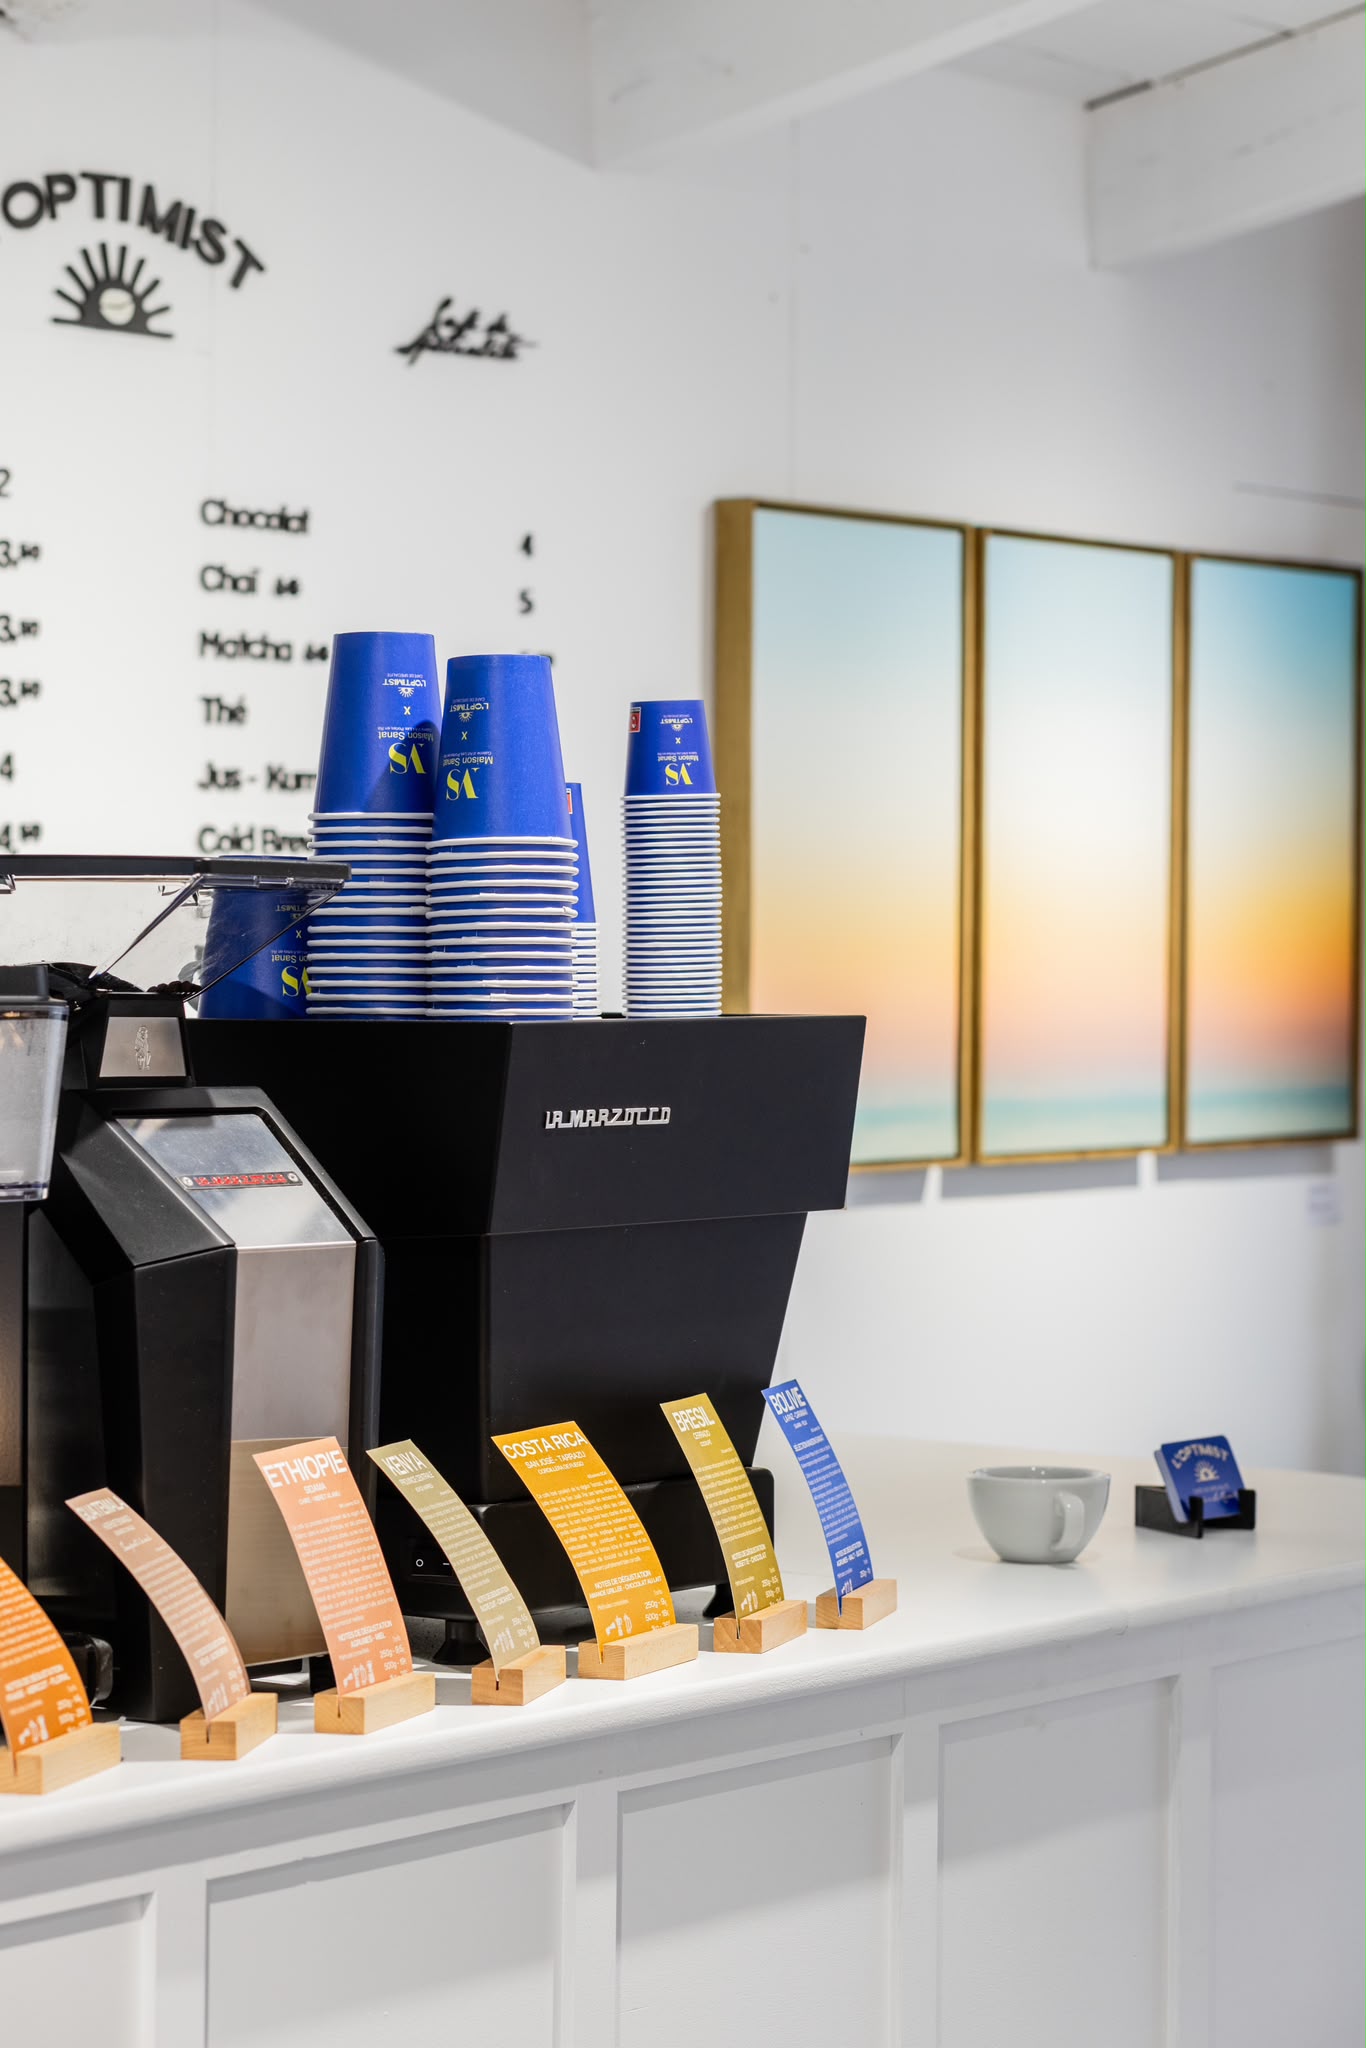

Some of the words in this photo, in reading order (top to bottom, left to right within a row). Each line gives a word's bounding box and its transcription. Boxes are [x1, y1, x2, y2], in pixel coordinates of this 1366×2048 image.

[200, 499, 308, 534] Chocolat
[519, 590, 533, 614] 5
[200, 632, 292, 662] Matcha
[382, 678, 427, 688] L'OPTIMIST
[201, 695, 246, 723] Thé
[378, 731, 405, 740] Sanat
[407, 731, 434, 742] Maison
[462, 755, 494, 765] Maison
[658, 755, 677, 763] Sanat
[199, 763, 241, 790] Jus
[199, 826, 254, 853] Cold
[272, 954, 297, 964] Sanat
[768, 1386, 807, 1416] BOLIVIE
[671, 1405, 716, 1433] BRESIL
[502, 1437, 554, 1460] COSTA
[551, 1431, 588, 1450] RICA
[262, 1449, 348, 1489] ETHIOPIE
[380, 1451, 428, 1477] KENYA
[525, 1461, 538, 1469] SAN
[645, 1600, 658, 1610] 250g
[646, 1614, 659, 1622] 500g
